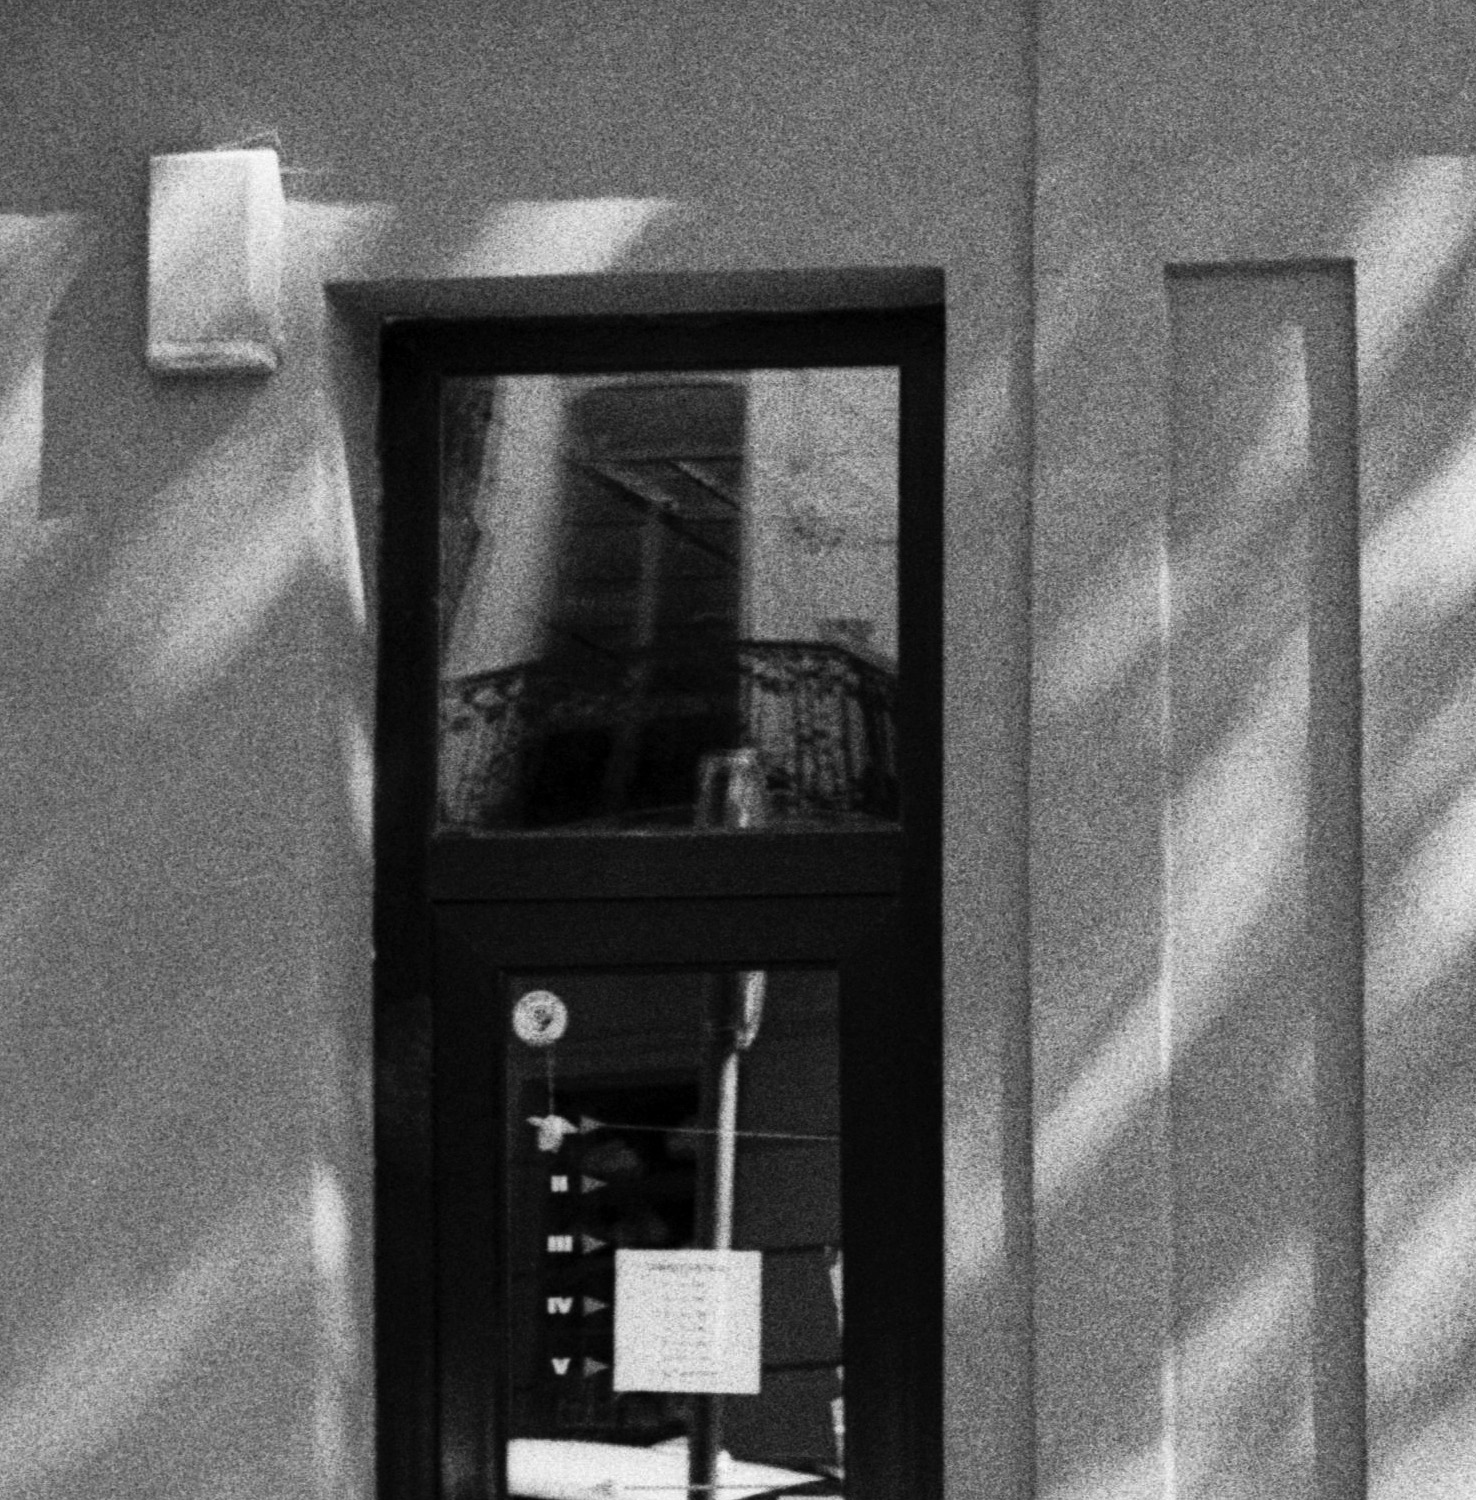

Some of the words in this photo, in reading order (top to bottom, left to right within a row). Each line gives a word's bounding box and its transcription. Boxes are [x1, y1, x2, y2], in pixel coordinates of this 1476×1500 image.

[550, 1174, 570, 1193] II
[546, 1234, 574, 1253] III
[546, 1296, 574, 1315] IV
[550, 1357, 571, 1376] V
